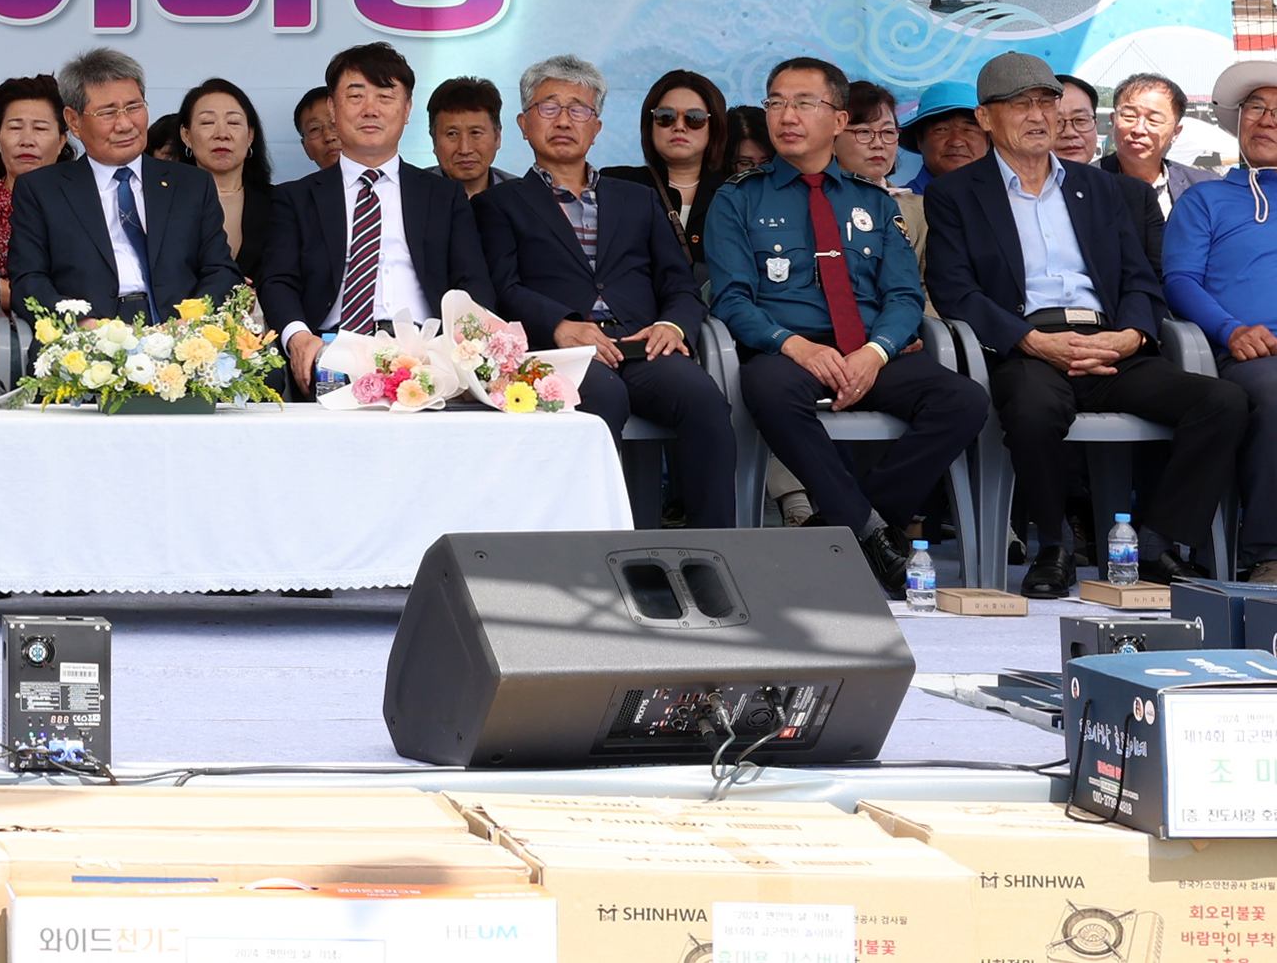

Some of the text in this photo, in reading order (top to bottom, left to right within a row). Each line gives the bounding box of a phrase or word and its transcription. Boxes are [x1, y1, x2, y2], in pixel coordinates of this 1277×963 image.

[1183, 729, 1277, 743] 제14회 고군면
[1209, 758, 1233, 784] 조
[1208, 808, 1256, 823] 진도사랑
[1003, 874, 1086, 890] SHINHWA
[1249, 880, 1276, 891] 검사필
[622, 906, 708, 923] SHINHWA
[880, 915, 908, 926] 검사필
[1188, 904, 1267, 922] 회오리불꽃
[445, 924, 519, 940] HEUM
[723, 925, 845, 940] 제14회 고군면민 놀이마당
[1180, 930, 1276, 948] 바람막이 부착
